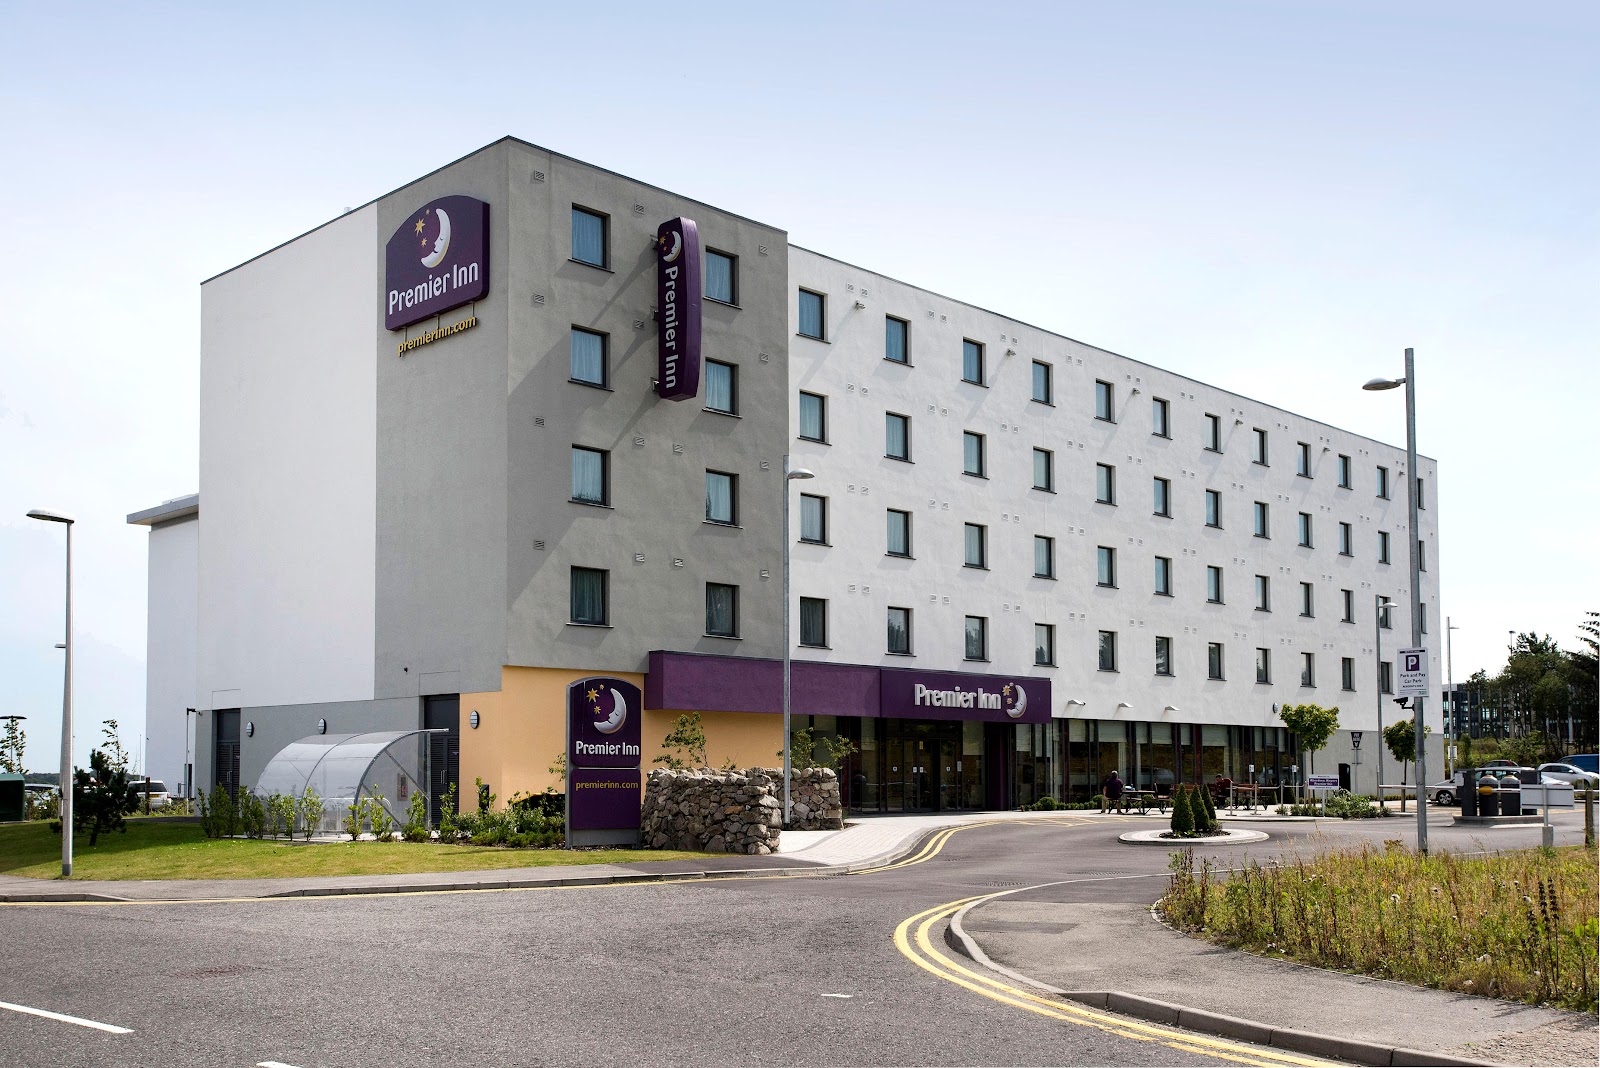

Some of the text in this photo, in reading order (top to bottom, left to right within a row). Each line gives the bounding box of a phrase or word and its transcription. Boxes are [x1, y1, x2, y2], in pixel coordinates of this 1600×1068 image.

[389, 262, 478, 315] Premier Inn
[398, 316, 477, 357] premierinn.com
[665, 265, 678, 389] Premier Inn
[1408, 656, 1417, 670] P
[914, 683, 1001, 710] Premier Inn
[575, 740, 639, 755] Premier Inn
[575, 780, 639, 791] premierinn.com
